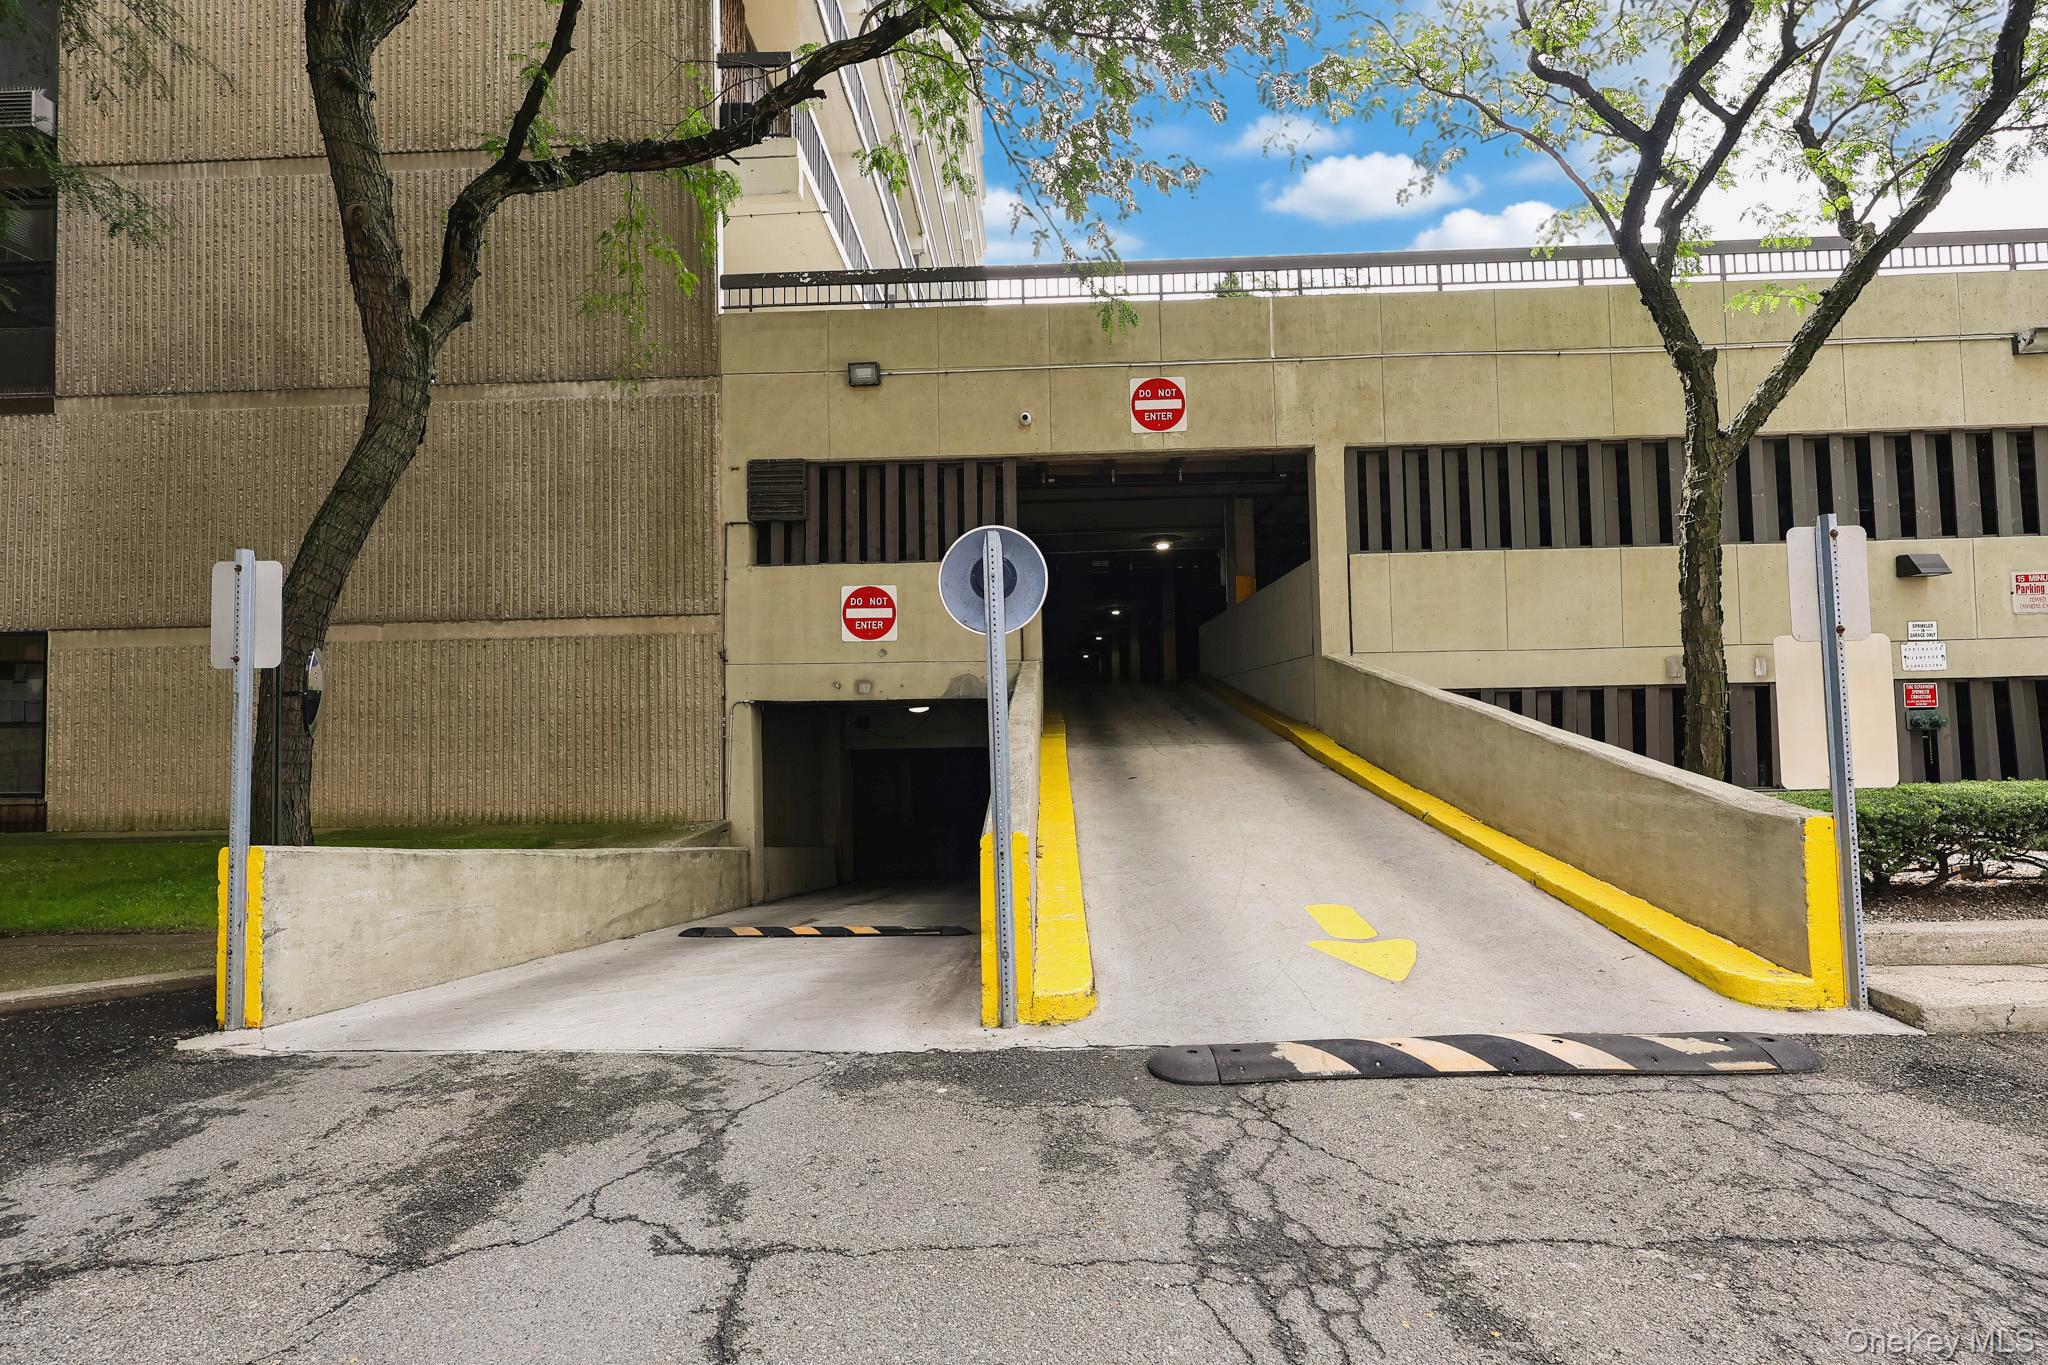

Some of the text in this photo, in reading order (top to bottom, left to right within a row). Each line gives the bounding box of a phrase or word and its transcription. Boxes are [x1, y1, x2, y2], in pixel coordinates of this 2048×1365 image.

[1139, 388, 1177, 397] DO NOT
[1144, 412, 1173, 421] ENTER
[2016, 575, 2025, 583] 15
[2016, 584, 2045, 595] Parking
[850, 597, 888, 606] DO NOT
[855, 621, 883, 630] ENTER
